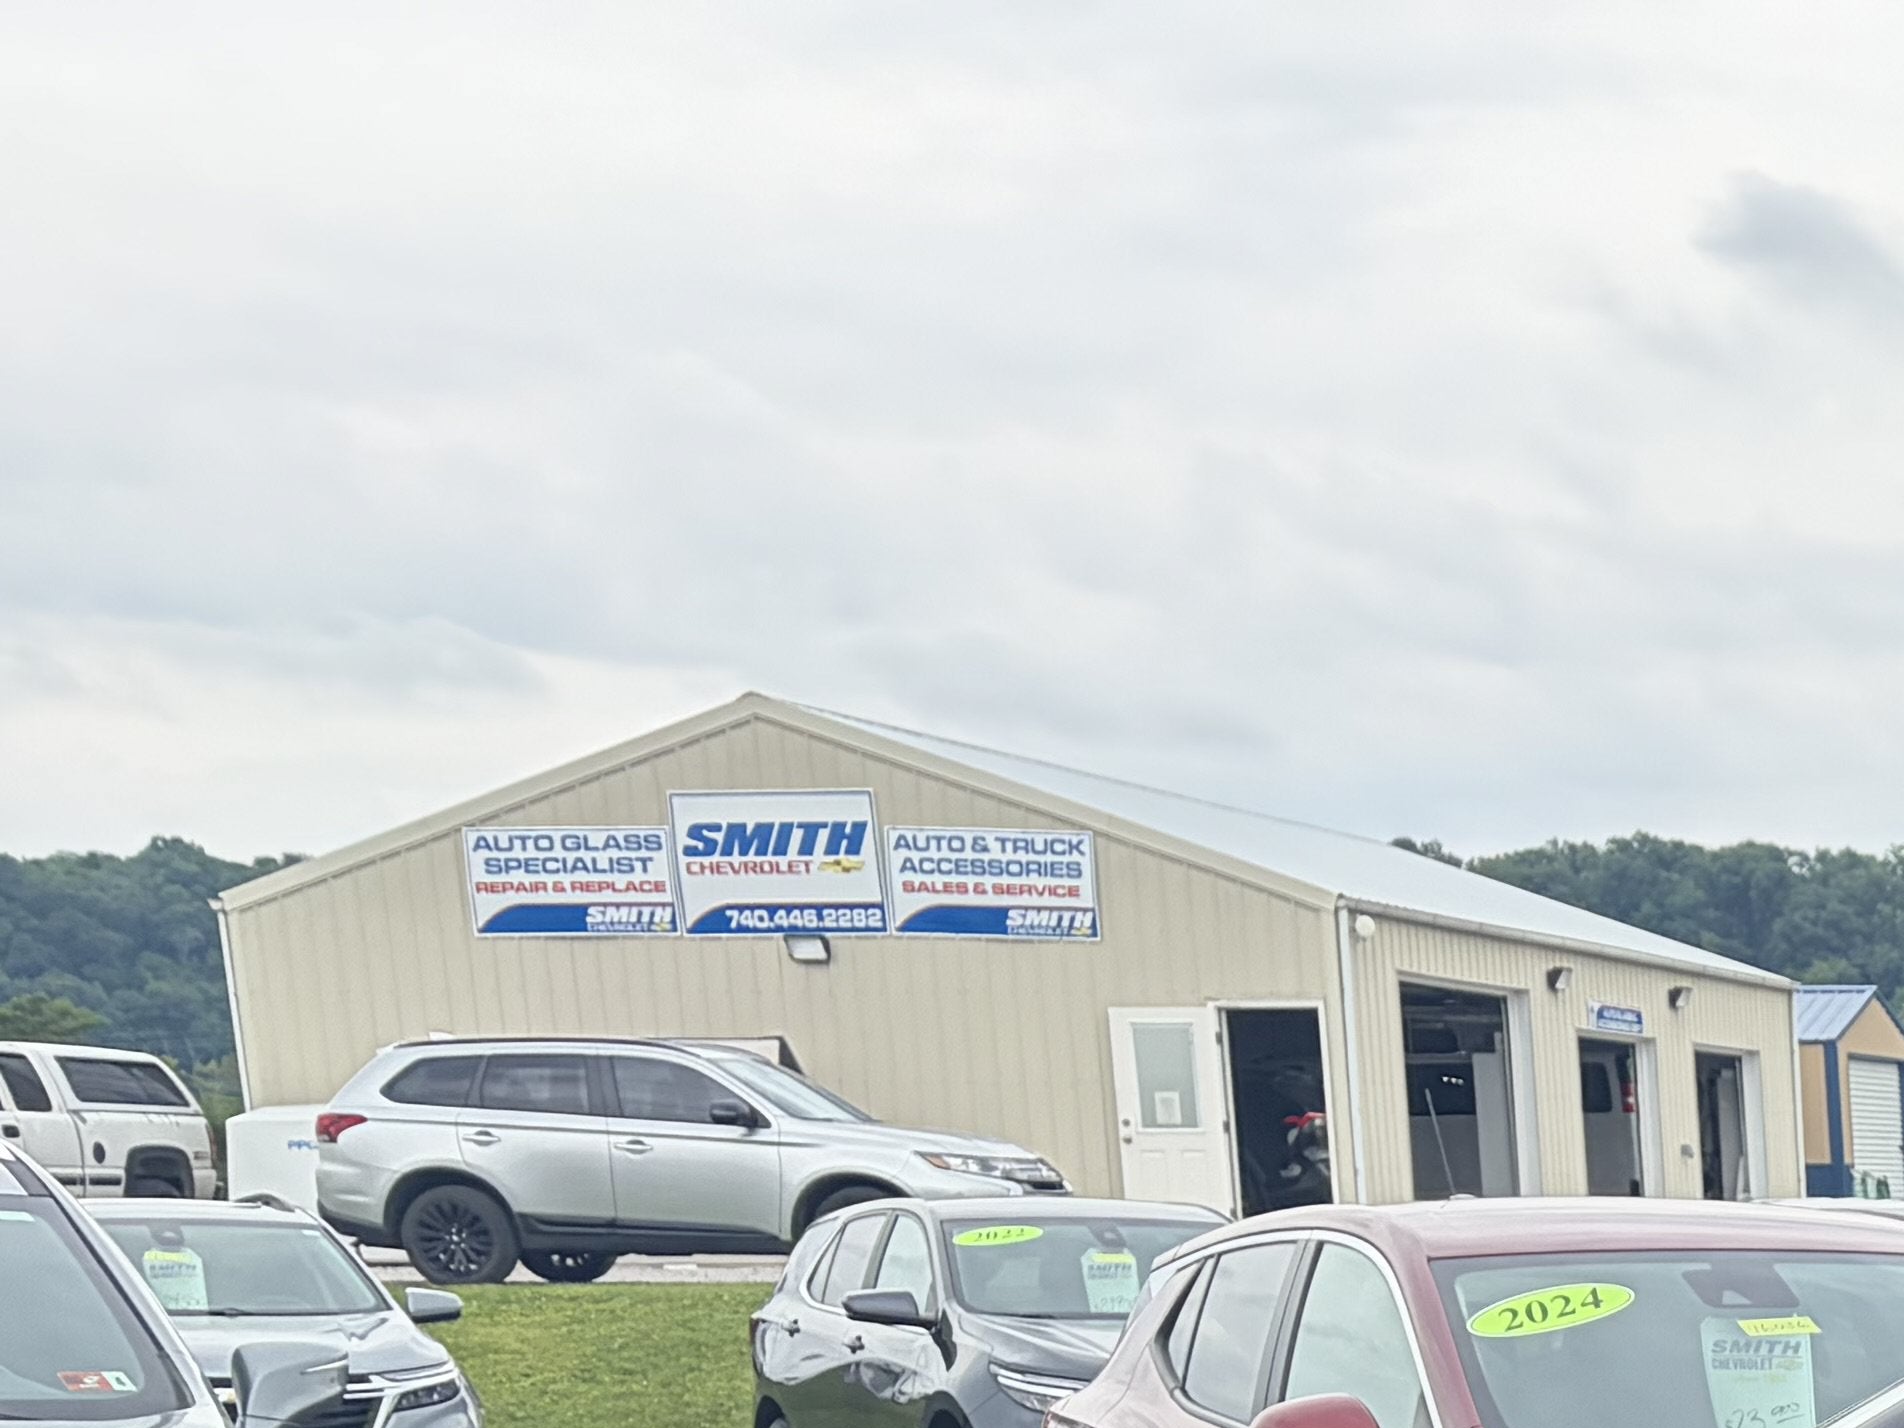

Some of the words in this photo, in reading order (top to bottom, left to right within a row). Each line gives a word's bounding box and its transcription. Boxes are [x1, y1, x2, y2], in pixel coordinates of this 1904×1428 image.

[473, 835, 555, 853] AUTO
[560, 834, 663, 851] GLASS
[682, 820, 868, 857] SMITH
[893, 834, 966, 853] AUTO
[971, 835, 990, 854] &
[994, 837, 1086, 856] TRUCK
[484, 856, 654, 875] SPECIALIST
[685, 860, 814, 876] CHEVROLET
[899, 857, 1083, 879] ACCESSORIES
[475, 881, 548, 894] REPAIR
[552, 881, 566, 893] &
[570, 880, 666, 893] REPLACE
[901, 880, 969, 895] SALES
[973, 882, 988, 895] &
[992, 883, 1081, 898] SERVICE
[586, 906, 673, 923] SMITH
[1006, 909, 1094, 928] SMITH
[1498, 1287, 1604, 1332] 2024
[1711, 1339, 1802, 1355] SMITH
[1711, 1358, 1774, 1371] CHEVROLET
